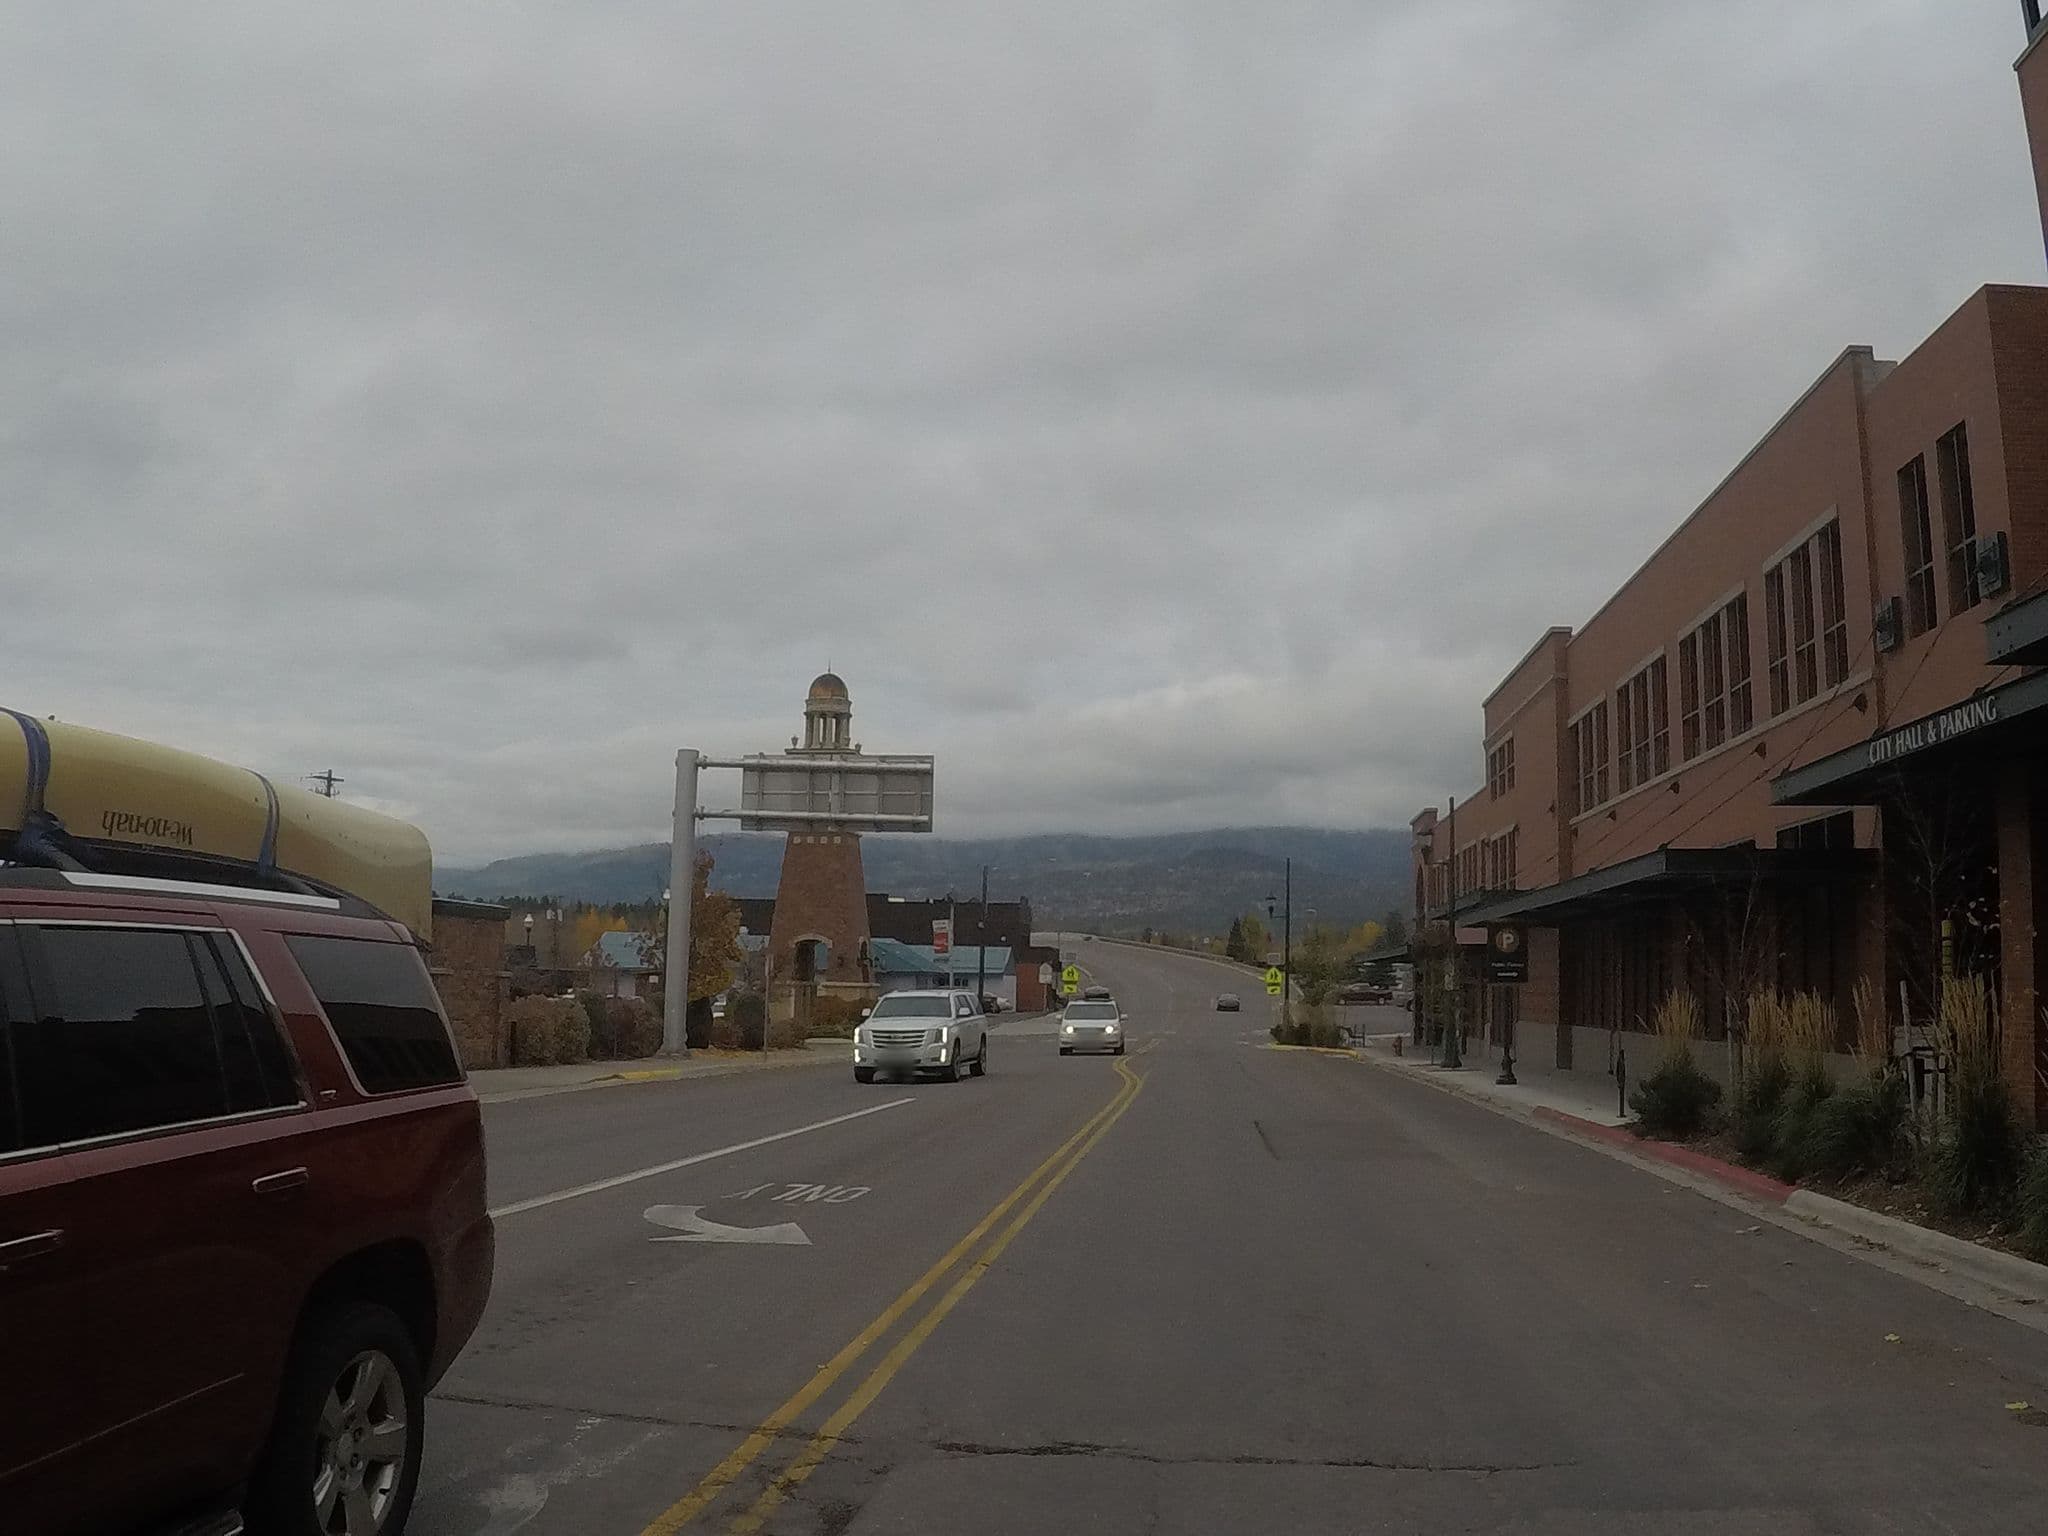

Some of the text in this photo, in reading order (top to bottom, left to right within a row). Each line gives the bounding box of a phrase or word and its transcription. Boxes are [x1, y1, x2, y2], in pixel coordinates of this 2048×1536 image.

[1869, 695, 1998, 764] CITY HALL & PARKING
[1503, 932, 1515, 948] P
[720, 1182, 872, 1203] ONLY
